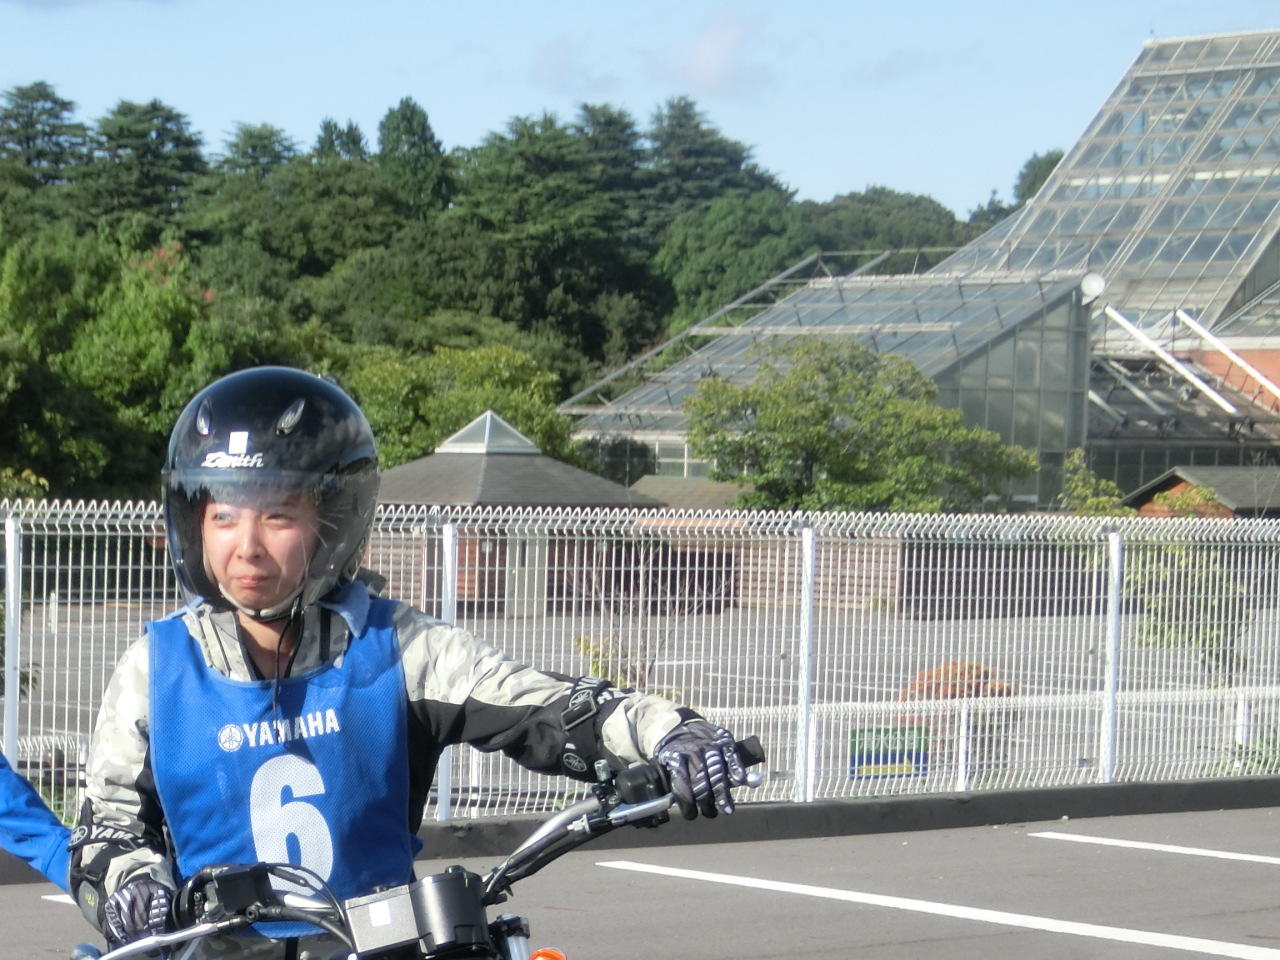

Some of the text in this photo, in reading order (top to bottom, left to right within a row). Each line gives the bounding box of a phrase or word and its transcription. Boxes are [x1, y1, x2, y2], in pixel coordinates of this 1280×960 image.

[201, 451, 264, 469] Zenith
[242, 708, 341, 748] YAMAHA
[250, 754, 334, 896] 6
